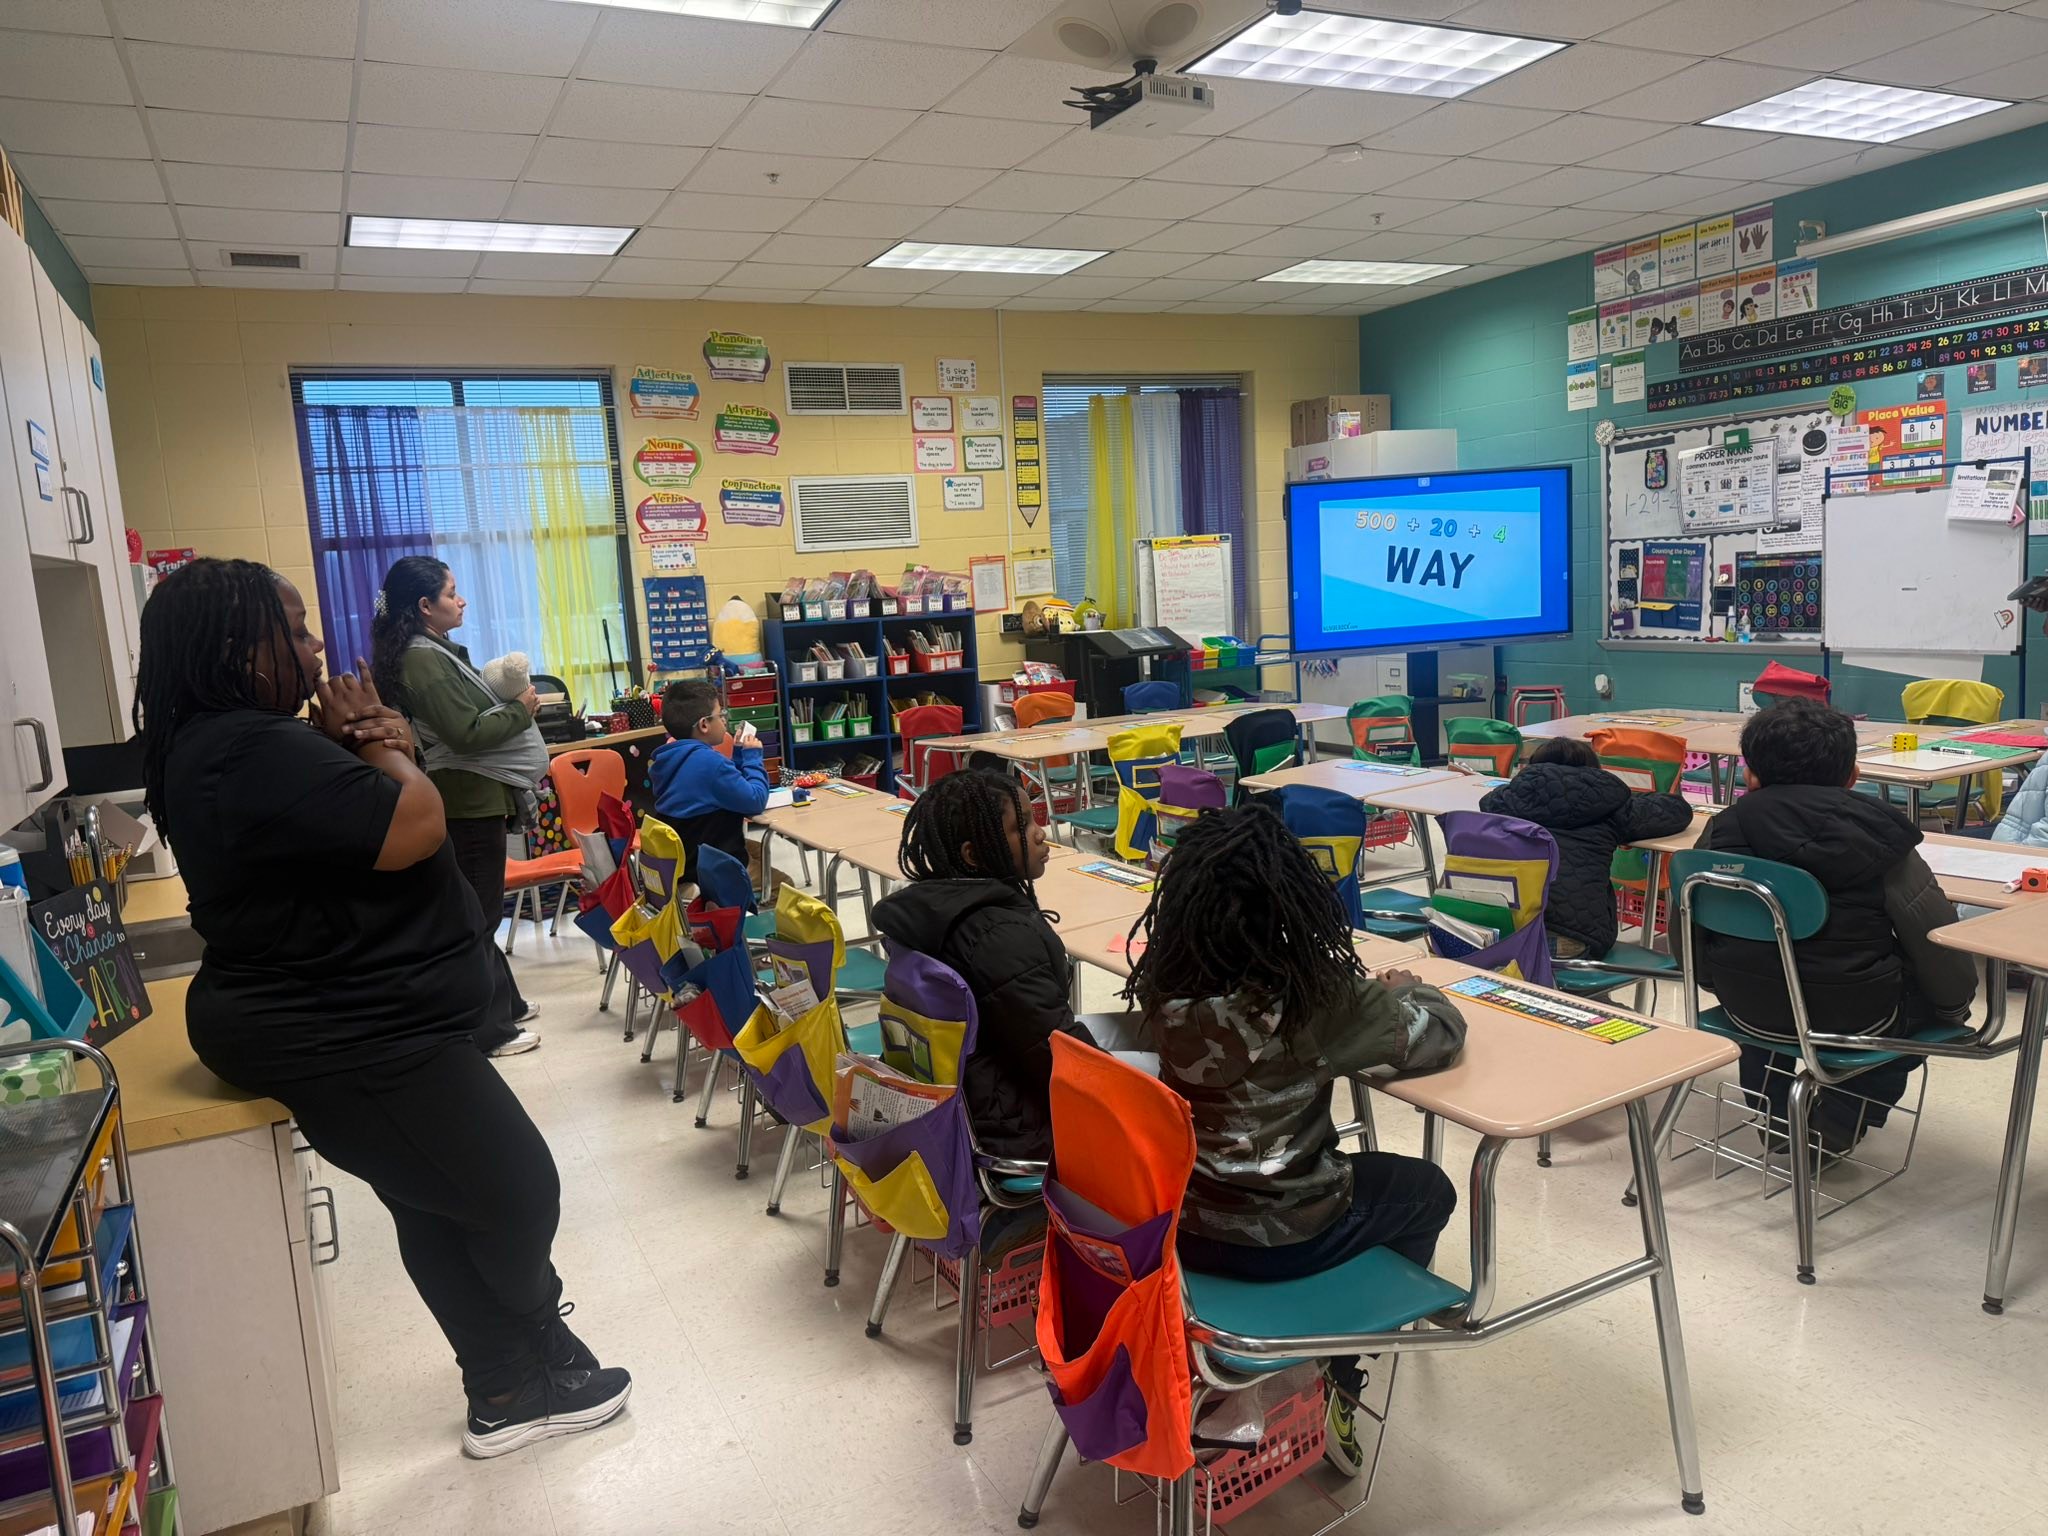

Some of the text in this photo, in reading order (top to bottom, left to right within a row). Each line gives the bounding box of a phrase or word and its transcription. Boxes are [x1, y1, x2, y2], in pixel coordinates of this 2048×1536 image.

[1681, 274, 2048, 360] Aa Bb Cc Dd Ee Ff Gg Hh Ii Jj Kk Ll M
[710, 331, 762, 345] Pronouns
[1756, 368, 1763, 376] 12
[1767, 367, 1774, 375] 13
[1779, 365, 1786, 373] 14
[1790, 364, 1798, 372] 15
[1802, 361, 1810, 369] 16
[1830, 356, 1838, 365] 18
[1842, 354, 1850, 362] 19
[1853, 352, 1864, 361] 20
[1867, 350, 1876, 359] 21
[1880, 347, 1890, 356] 22
[1893, 345, 1903, 354] 23
[1907, 342, 1917, 352] 24
[1921, 340, 1931, 349] 25
[1938, 336, 1949, 346] 26
[1952, 334, 1963, 344] 27
[1967, 332, 1978, 341] 28
[1982, 329, 1993, 339] 29
[1997, 326, 2008, 336] 30
[2014, 324, 2023, 334] 31
[2028, 321, 2040, 332] 32
[637, 368, 692, 380] Adjectives
[1668, 398, 1676, 406] 68
[1709, 391, 1717, 400] 72
[1719, 390, 1728, 398] 73
[1733, 387, 1742, 396] 74
[1744, 386, 1753, 394] 75
[1755, 384, 1764, 392] 76
[1767, 382, 1775, 390] 77
[1778, 380, 1788, 389] 78
[1790, 379, 1800, 387] 79
[1801, 377, 1811, 385] 80
[1815, 375, 1822, 384] 81
[1830, 372, 1839, 380] 82
[1842, 370, 1852, 379] 83
[1856, 368, 1865, 377] 84
[1869, 365, 1880, 374] 85
[1882, 363, 1894, 372] 86
[1897, 360, 1908, 370] 87
[1911, 358, 1922, 367] 88
[1939, 353, 1950, 362] 89
[1954, 351, 1965, 360] 90
[1971, 348, 1980, 358] 91
[1985, 346, 1997, 356] 92
[2000, 344, 2012, 353] 93
[2017, 342, 2028, 351] 94
[2033, 339, 2046, 348] 95
[947, 376, 969, 384] writing
[1831, 391, 1854, 402] Dream
[725, 404, 769, 417] Adverbs
[1834, 400, 1848, 409] BIG
[2010, 403, 2018, 412] to
[1868, 405, 1935, 421] Place Value
[1839, 426, 1861, 434] RULER
[1910, 422, 1936, 432] 8 6
[647, 439, 684, 450] Nouns
[1695, 450, 1725, 461] PROPER
[1686, 462, 1707, 470] common
[1734, 456, 1752, 465] proper
[1890, 462, 1894, 470] 3
[1909, 459, 1915, 467] 8
[1929, 457, 1935, 465] 6
[722, 479, 781, 491] Conjunctions
[653, 493, 685, 503] Verbs
[1355, 511, 1397, 531] 500
[1429, 518, 1458, 538] 20
[1493, 525, 1507, 544] 4
[1386, 545, 1475, 589] WAY
[44, 893, 111, 939] Every day
[64, 930, 126, 970] a Chance to
[80, 946, 143, 1036] ARN
